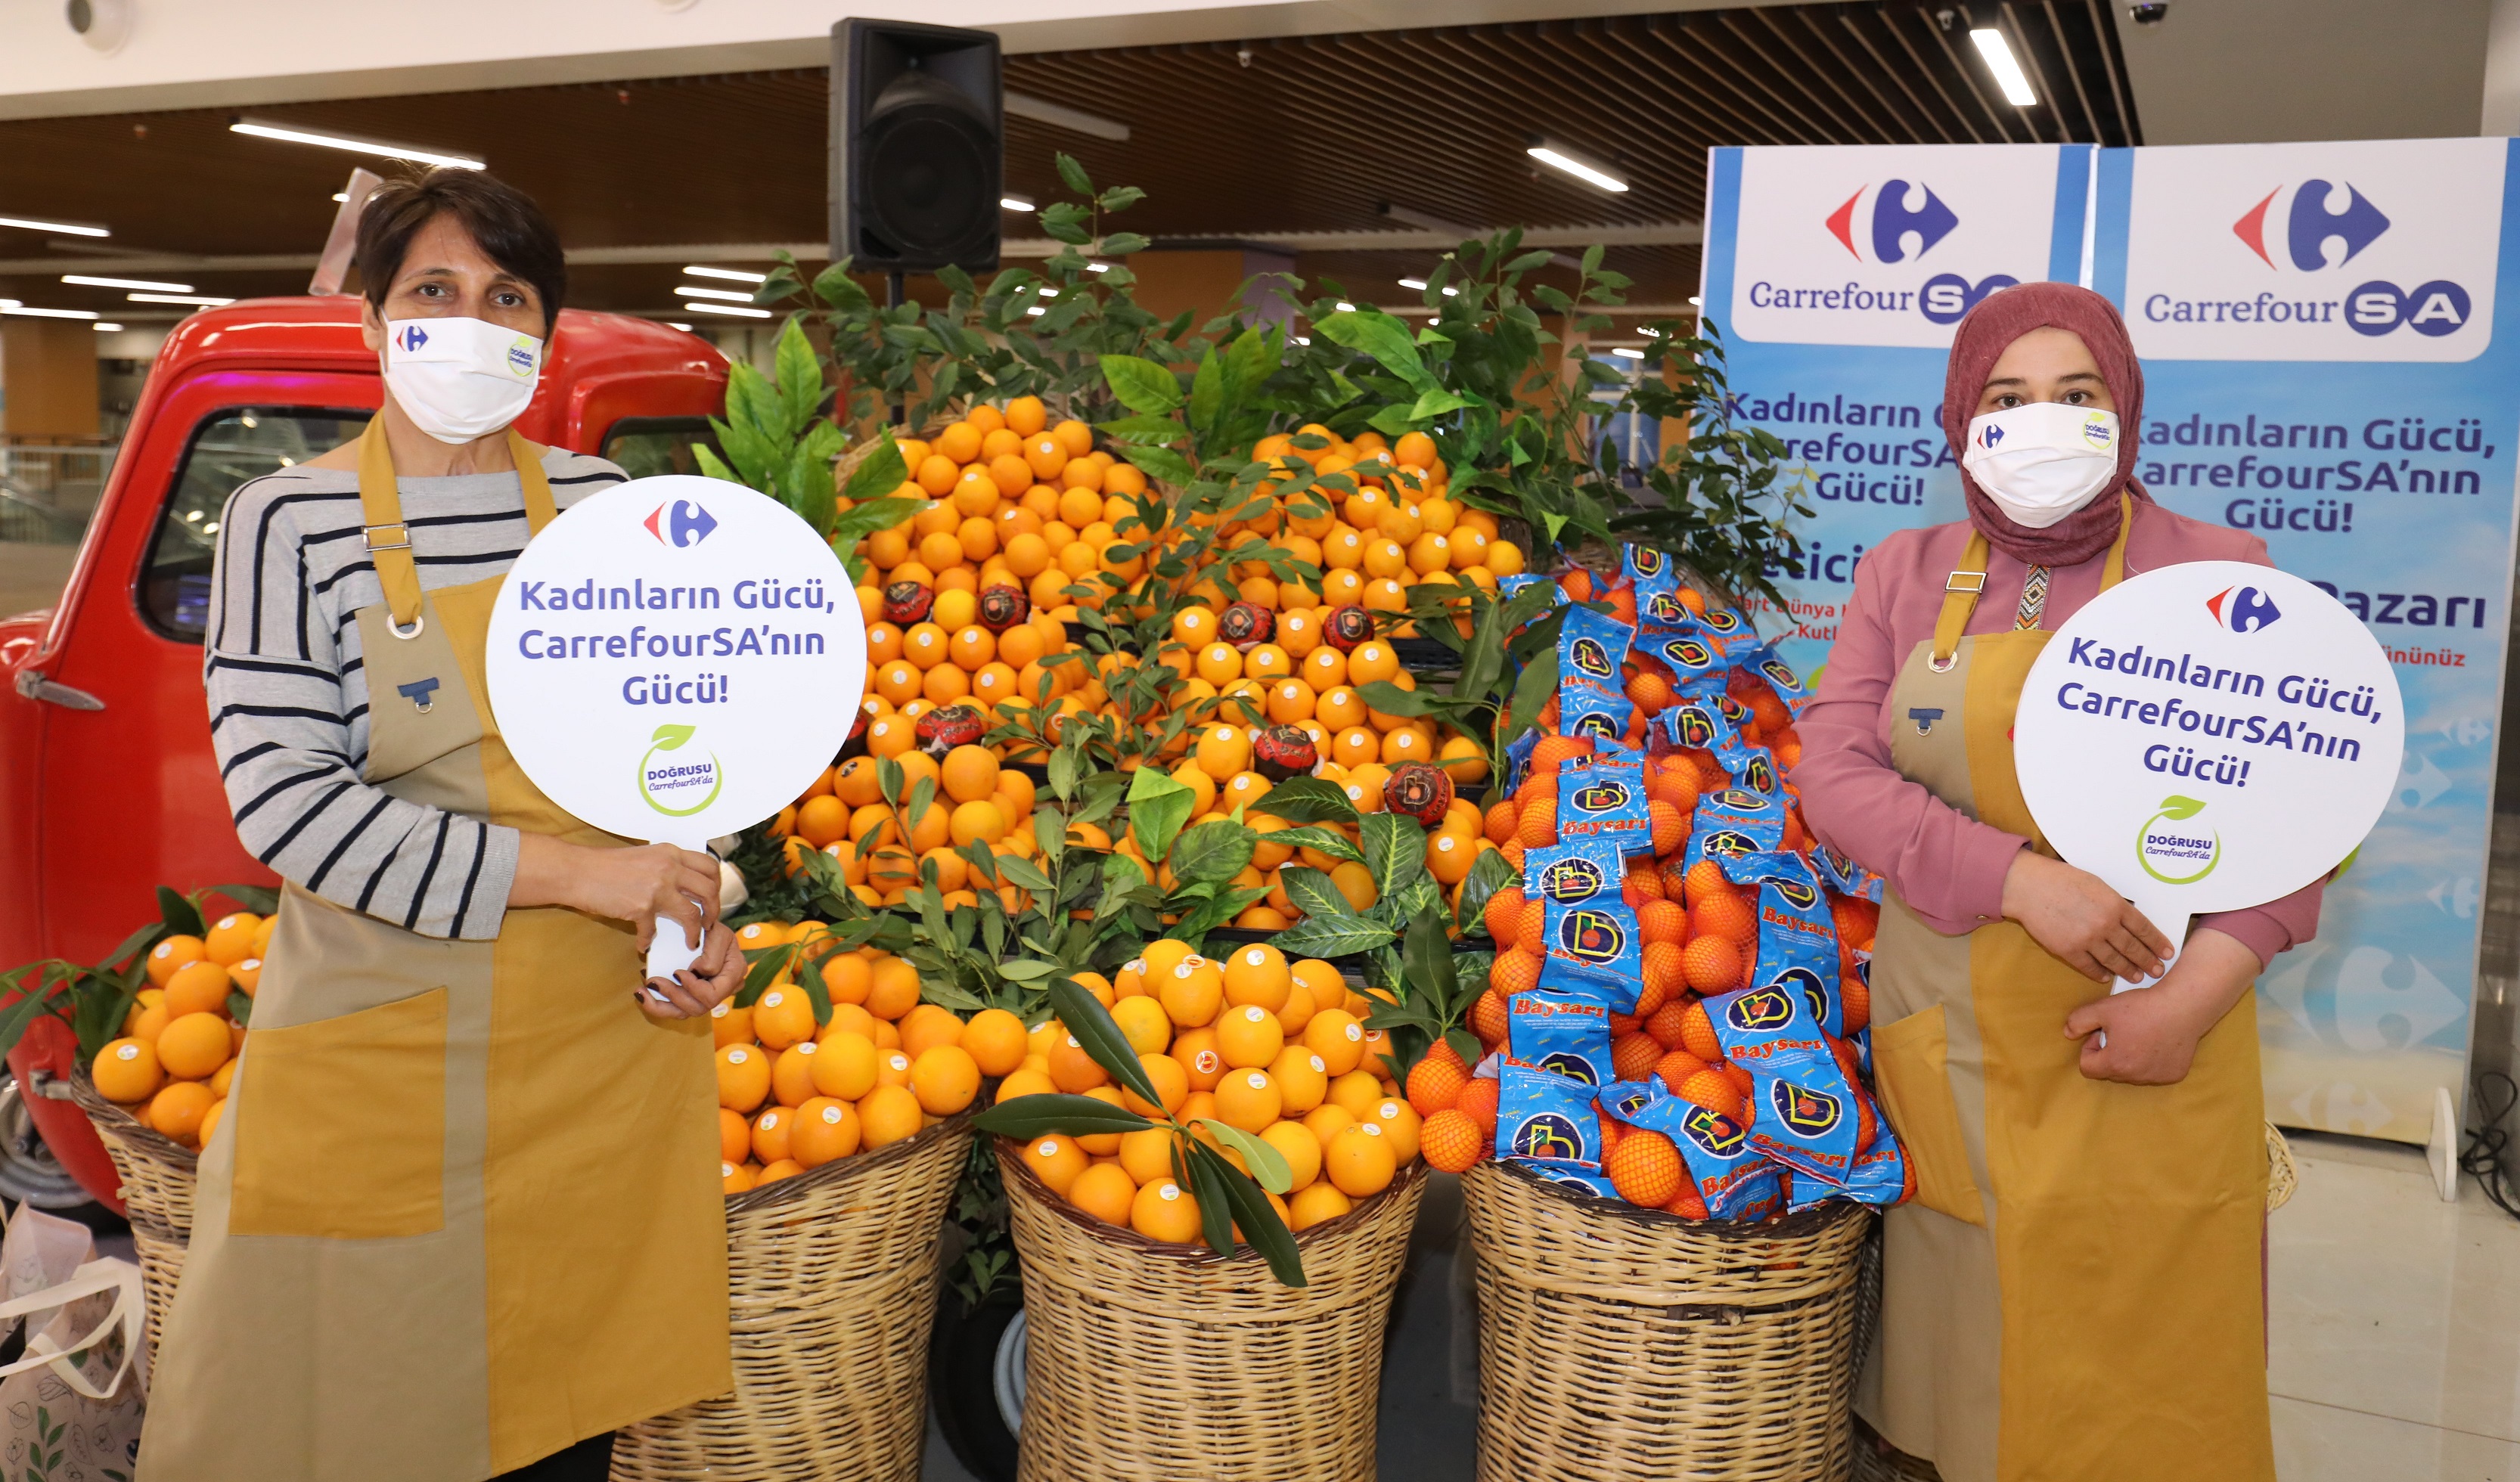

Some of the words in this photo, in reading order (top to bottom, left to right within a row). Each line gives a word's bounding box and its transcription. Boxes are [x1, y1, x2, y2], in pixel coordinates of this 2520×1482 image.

[1750, 281, 1914, 311] Carrefour
[2145, 292, 2338, 323] Carrefour
[1725, 392, 1921, 428] Kadınların
[2142, 413, 2348, 450] adınların
[2363, 417, 2496, 460] Gücü,
[1816, 472, 1924, 506] Gücü!
[2138, 455, 2482, 495] arrefourSA'nın
[2225, 498, 2354, 532] Gücü!
[520, 578, 720, 611] Kadınların
[733, 578, 834, 614] Gücü,
[1776, 597, 1836, 619] Dünya
[519, 624, 825, 659] CarrefourSA'nın
[622, 673, 728, 705] Gücü!
[2068, 636, 2264, 697] Kadınların
[2276, 674, 2382, 724] Gücü,
[2057, 681, 2361, 762] CarrefourSA'nın
[647, 764, 712, 780] DOĞRUSU
[2143, 742, 2252, 788] Gücü!
[648, 775, 714, 792] CarrefourSA'da
[1562, 818, 1646, 836] Baysarı
[2146, 834, 2213, 849] DOĞRUSU
[2146, 845, 2211, 860] CarrefourSA'da
[1761, 906, 1834, 939] Baysarı
[1513, 999, 1604, 1018] Baysarı
[1730, 1039, 1823, 1059] Baysarı
[1701, 1156, 1774, 1198] Baysar
